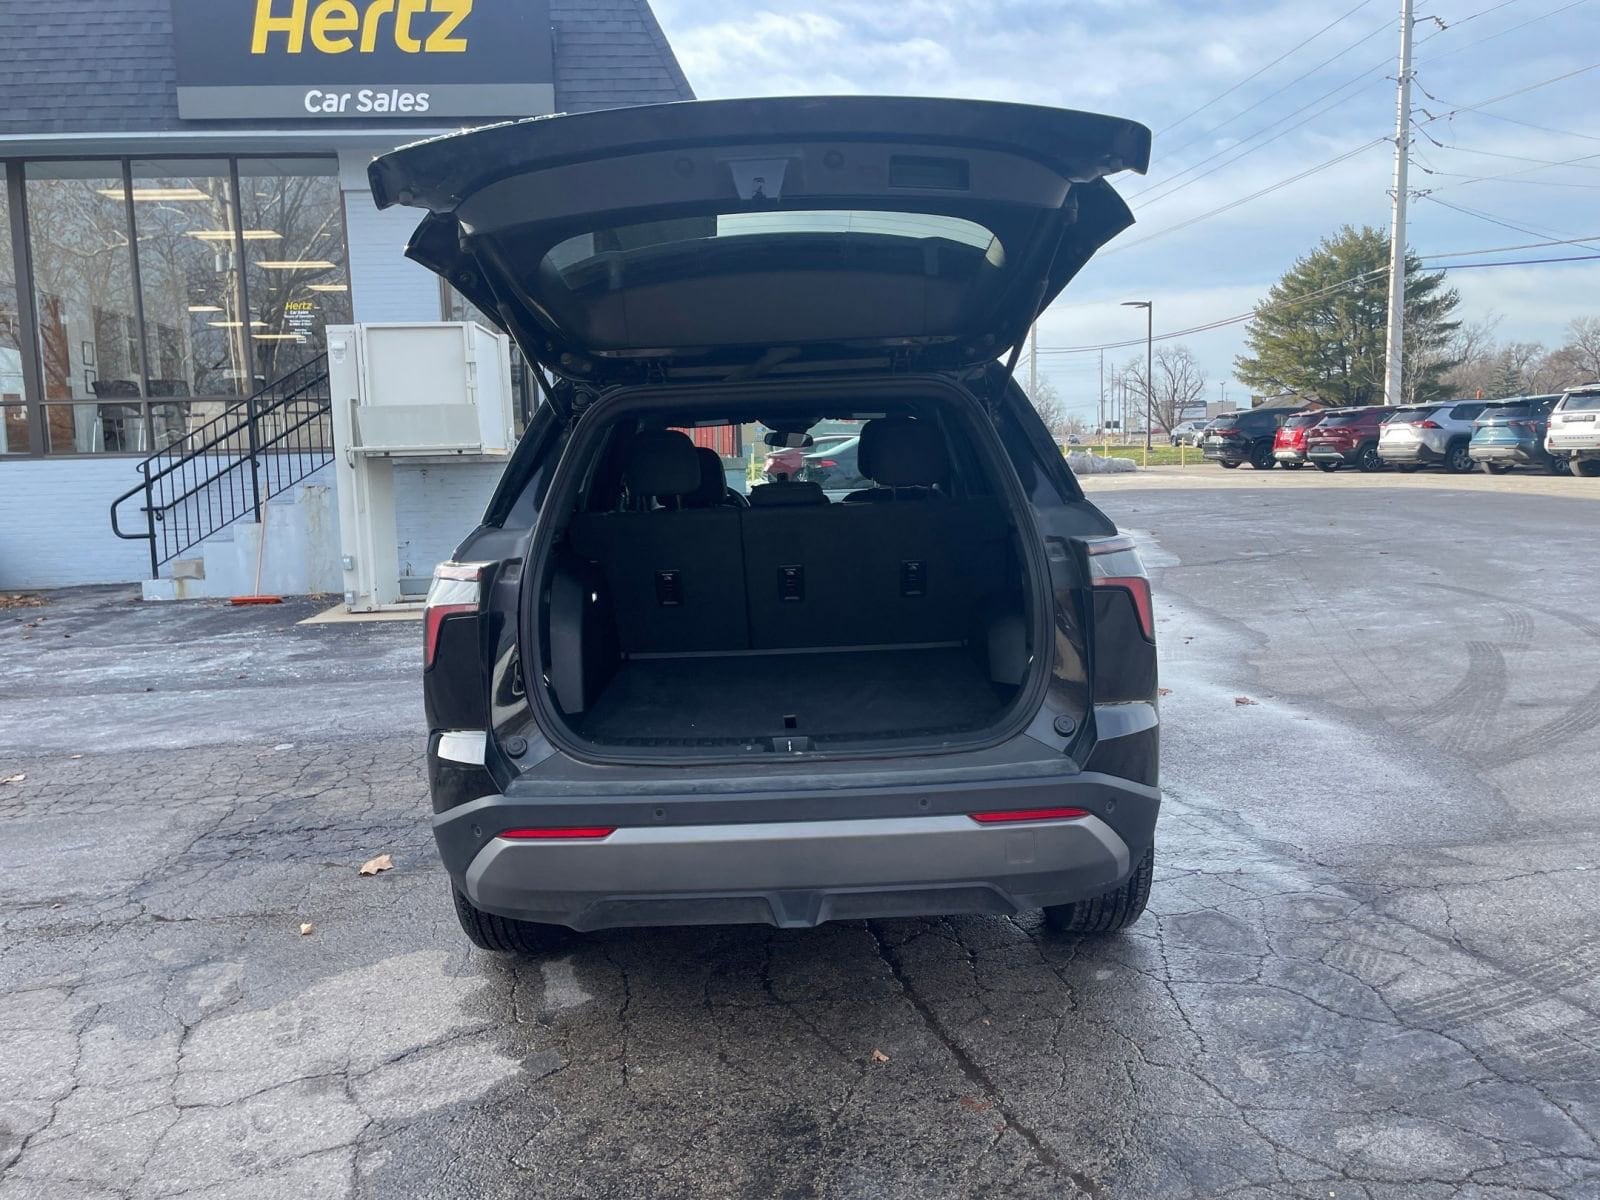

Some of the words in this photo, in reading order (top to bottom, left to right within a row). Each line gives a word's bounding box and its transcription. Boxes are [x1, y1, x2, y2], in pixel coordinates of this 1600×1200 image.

[250, 0, 473, 54] Hertz
[304, 90, 351, 113] Car
[357, 88, 430, 113] Sales
[285, 301, 312, 310] Hertz
